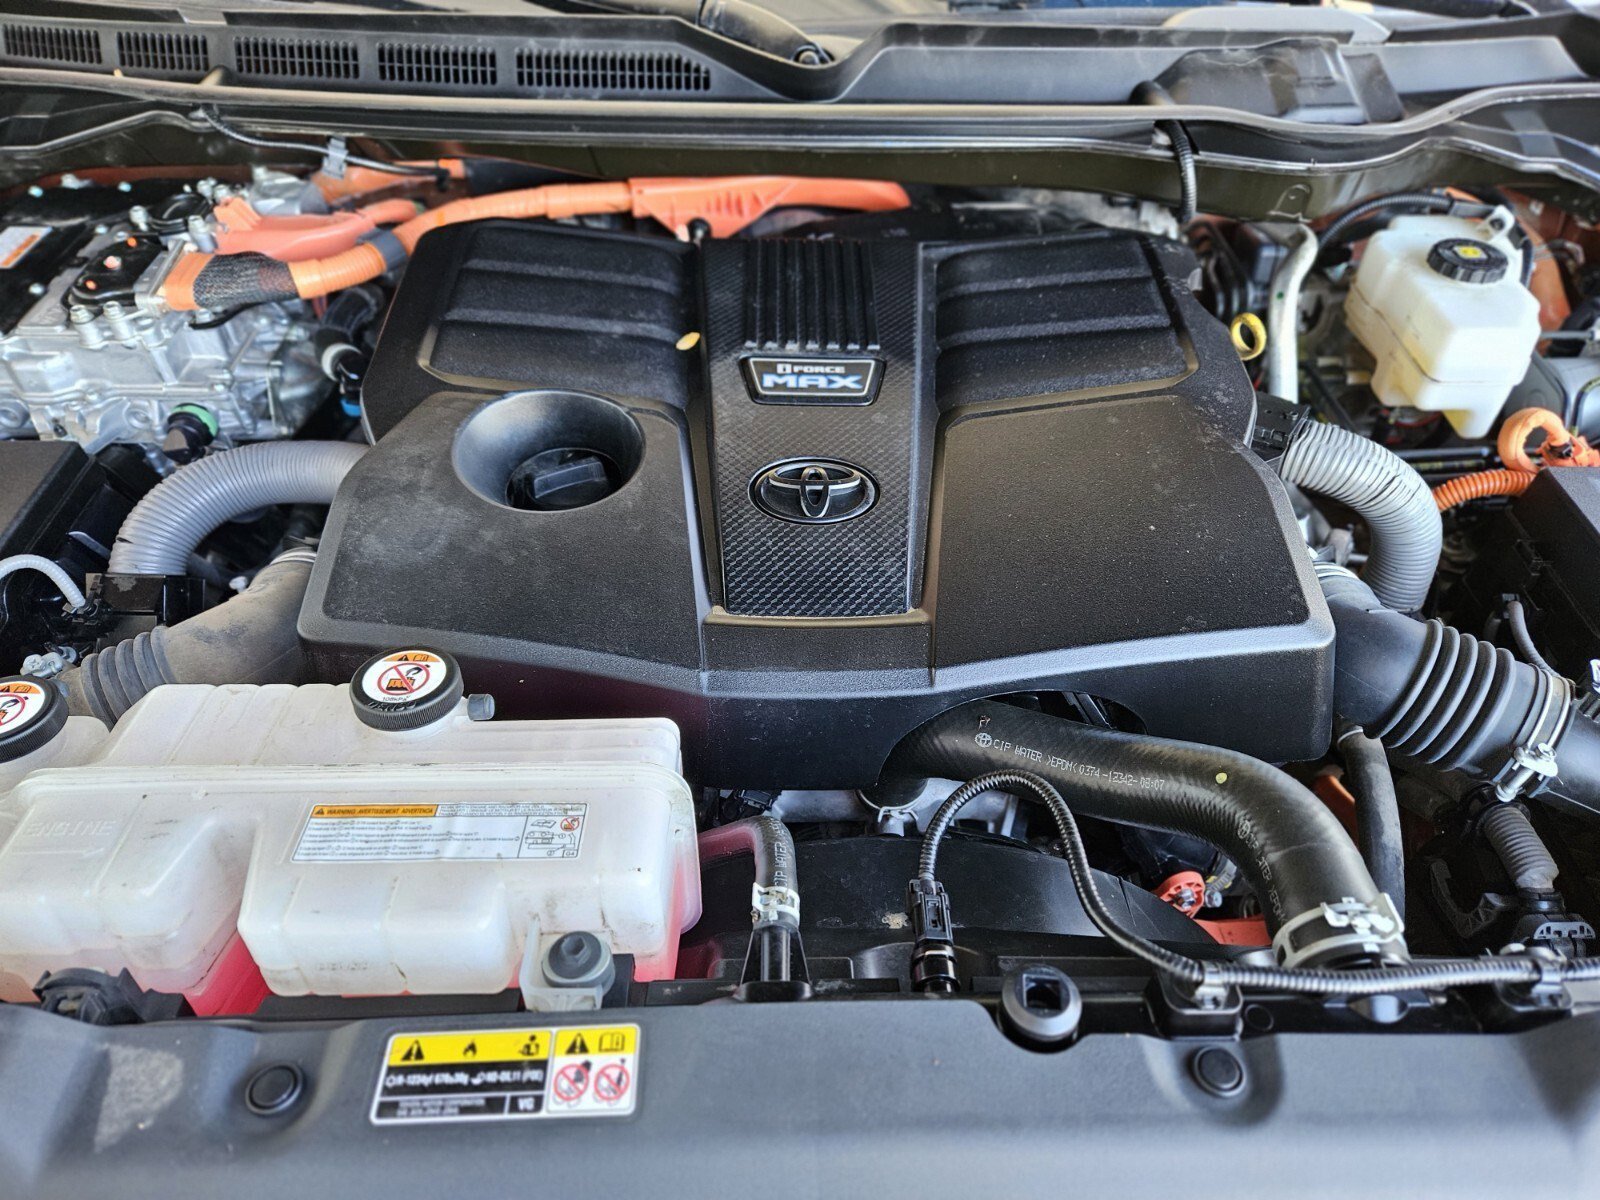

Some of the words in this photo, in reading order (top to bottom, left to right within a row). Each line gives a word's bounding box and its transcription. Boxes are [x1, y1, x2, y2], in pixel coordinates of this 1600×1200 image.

[793, 365, 845, 373] FORCE
[762, 373, 863, 389] MAX
[993, 739, 1011, 752] CIP
[1014, 745, 1043, 764] WATER
[774, 841, 788, 868] WATER
